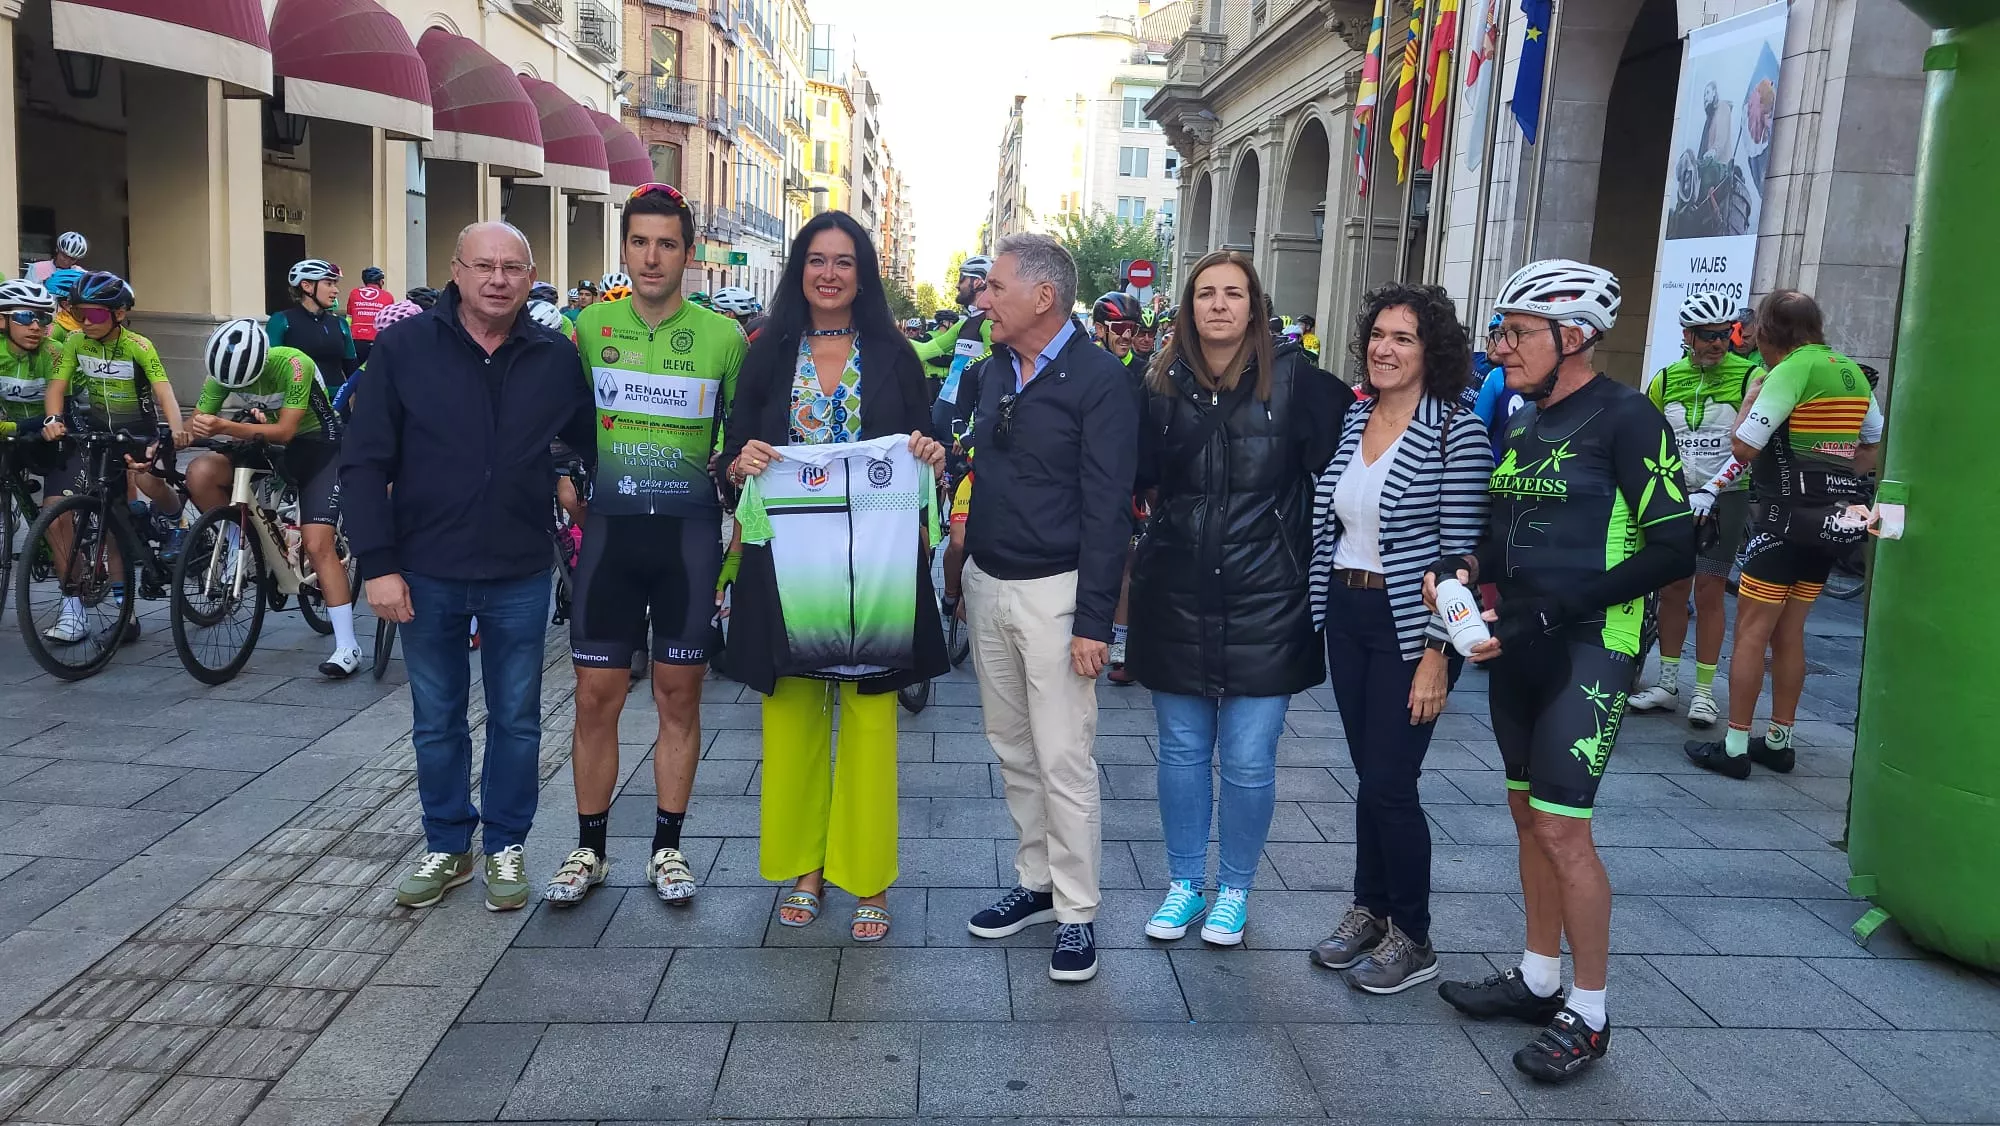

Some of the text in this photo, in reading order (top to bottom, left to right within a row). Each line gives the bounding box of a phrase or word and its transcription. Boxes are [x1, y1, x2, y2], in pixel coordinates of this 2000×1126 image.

[1690, 256, 1727, 273] VIAJES
[624, 383, 688, 399] RENAULT
[624, 393, 688, 407] AUTO CUATRO
[612, 441, 683, 460] Huesca
[1677, 438, 1720, 448] uesca
[640, 479, 689, 489] CASA PÉREZ
[1489, 476, 1567, 494] DELWEISS
[1592, 690, 1626, 777] EDELWEISS
